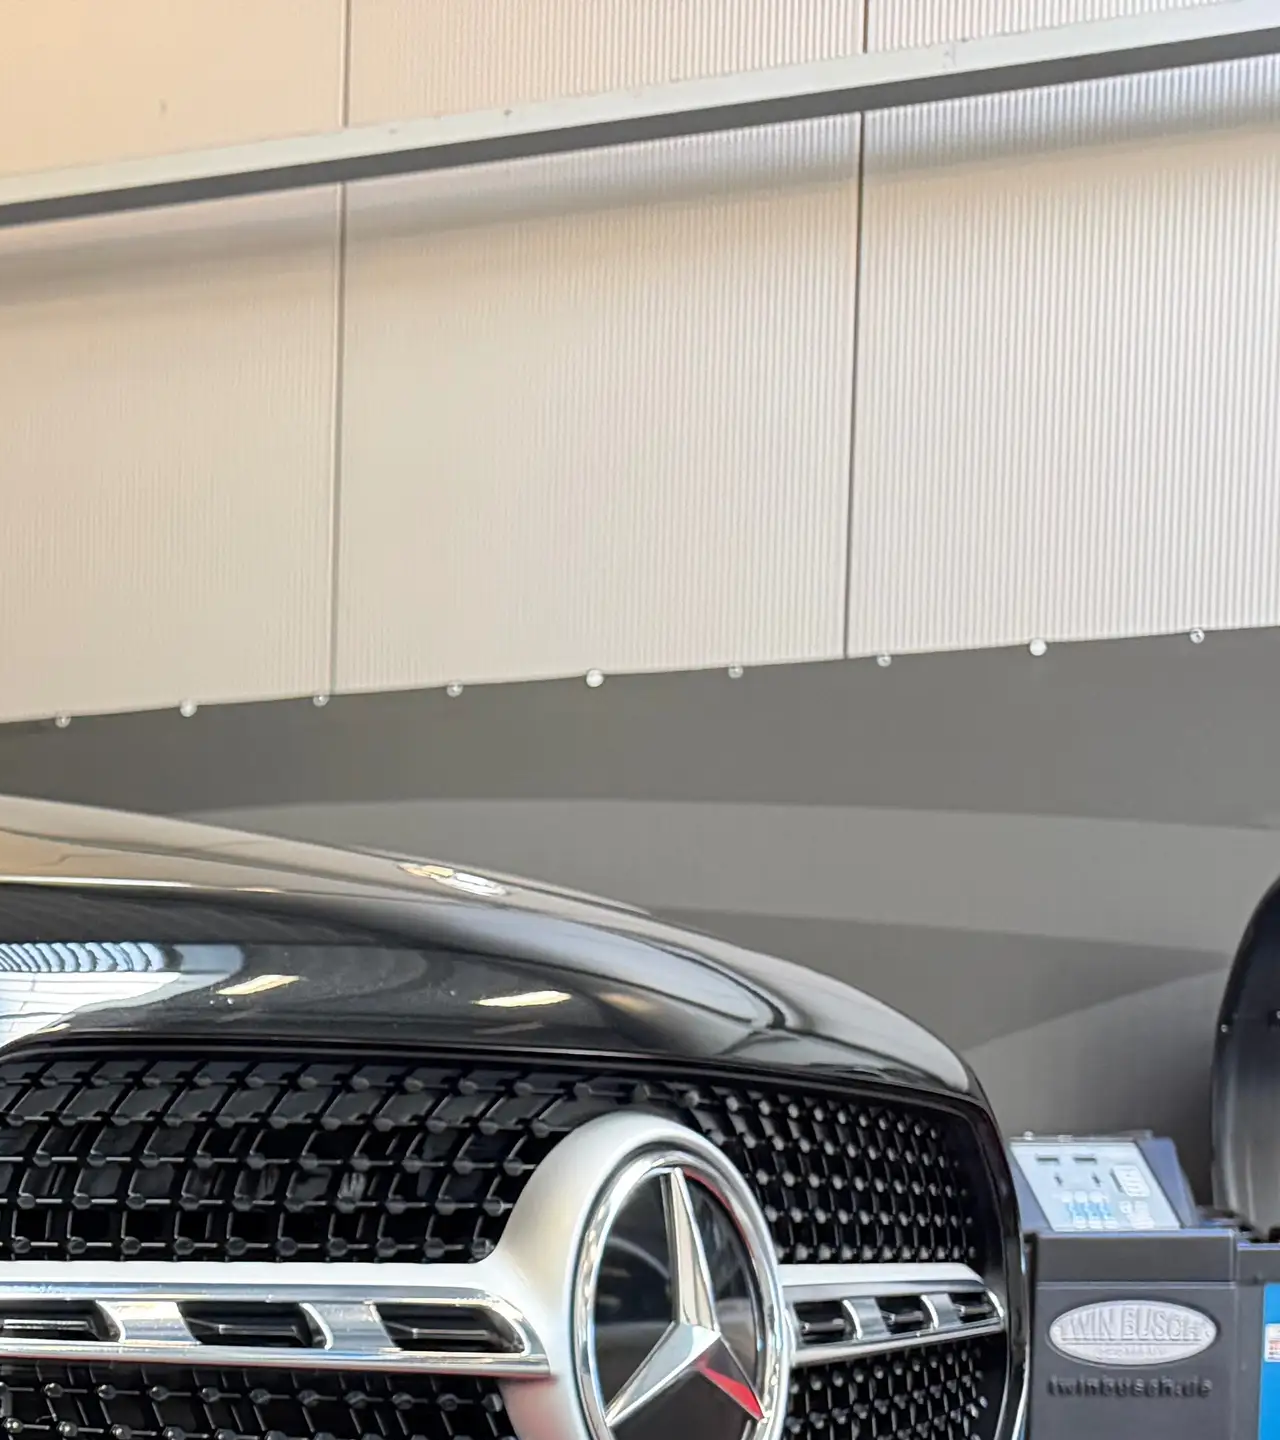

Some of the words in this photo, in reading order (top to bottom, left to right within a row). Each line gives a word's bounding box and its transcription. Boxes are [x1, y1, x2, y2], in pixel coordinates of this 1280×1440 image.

[1059, 1310, 1118, 1341] TWIN
[1120, 1309, 1203, 1341] BUSCH
[1048, 1374, 1214, 1400] twinbusch.de
